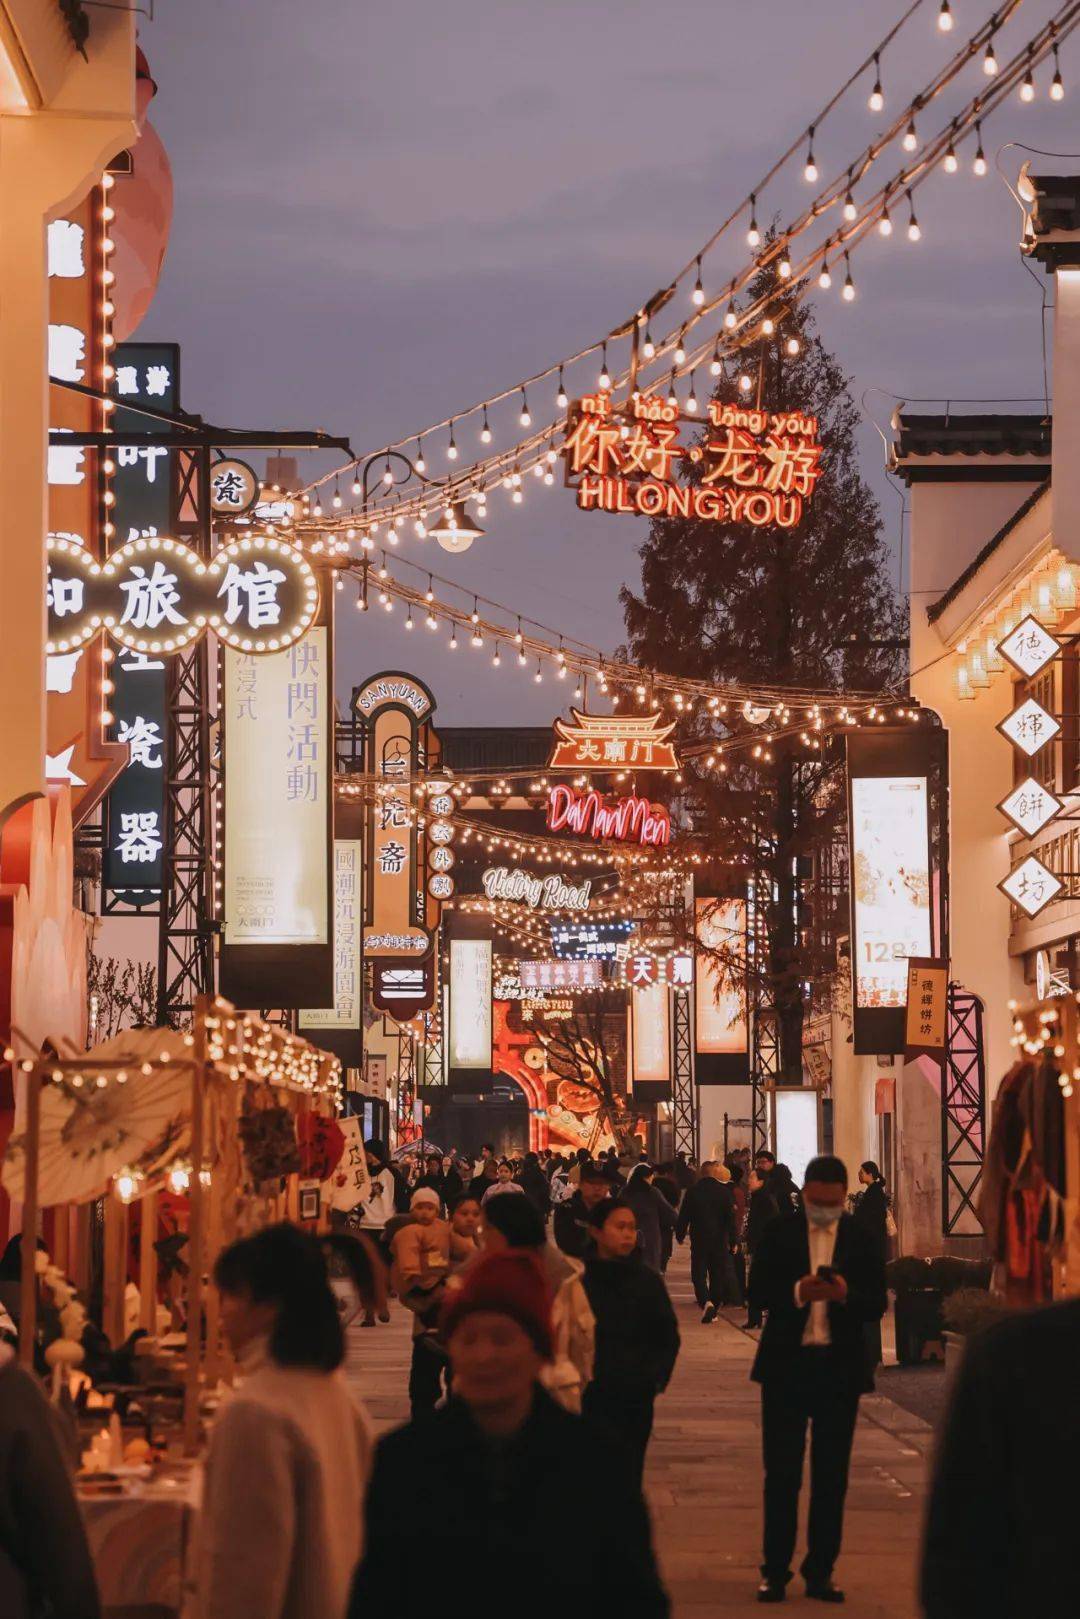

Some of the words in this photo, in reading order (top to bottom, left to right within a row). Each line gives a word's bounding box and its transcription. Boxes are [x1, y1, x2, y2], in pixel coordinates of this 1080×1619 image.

[213, 471, 244, 505] 瓷
[577, 480, 803, 529] HILONGYOU
[359, 682, 427, 711] SANYUAN
[285, 641, 320, 803] 快閃活動
[575, 739, 654, 764] 大南门
[482, 866, 544, 907] Victory
[543, 876, 593, 911] Road
